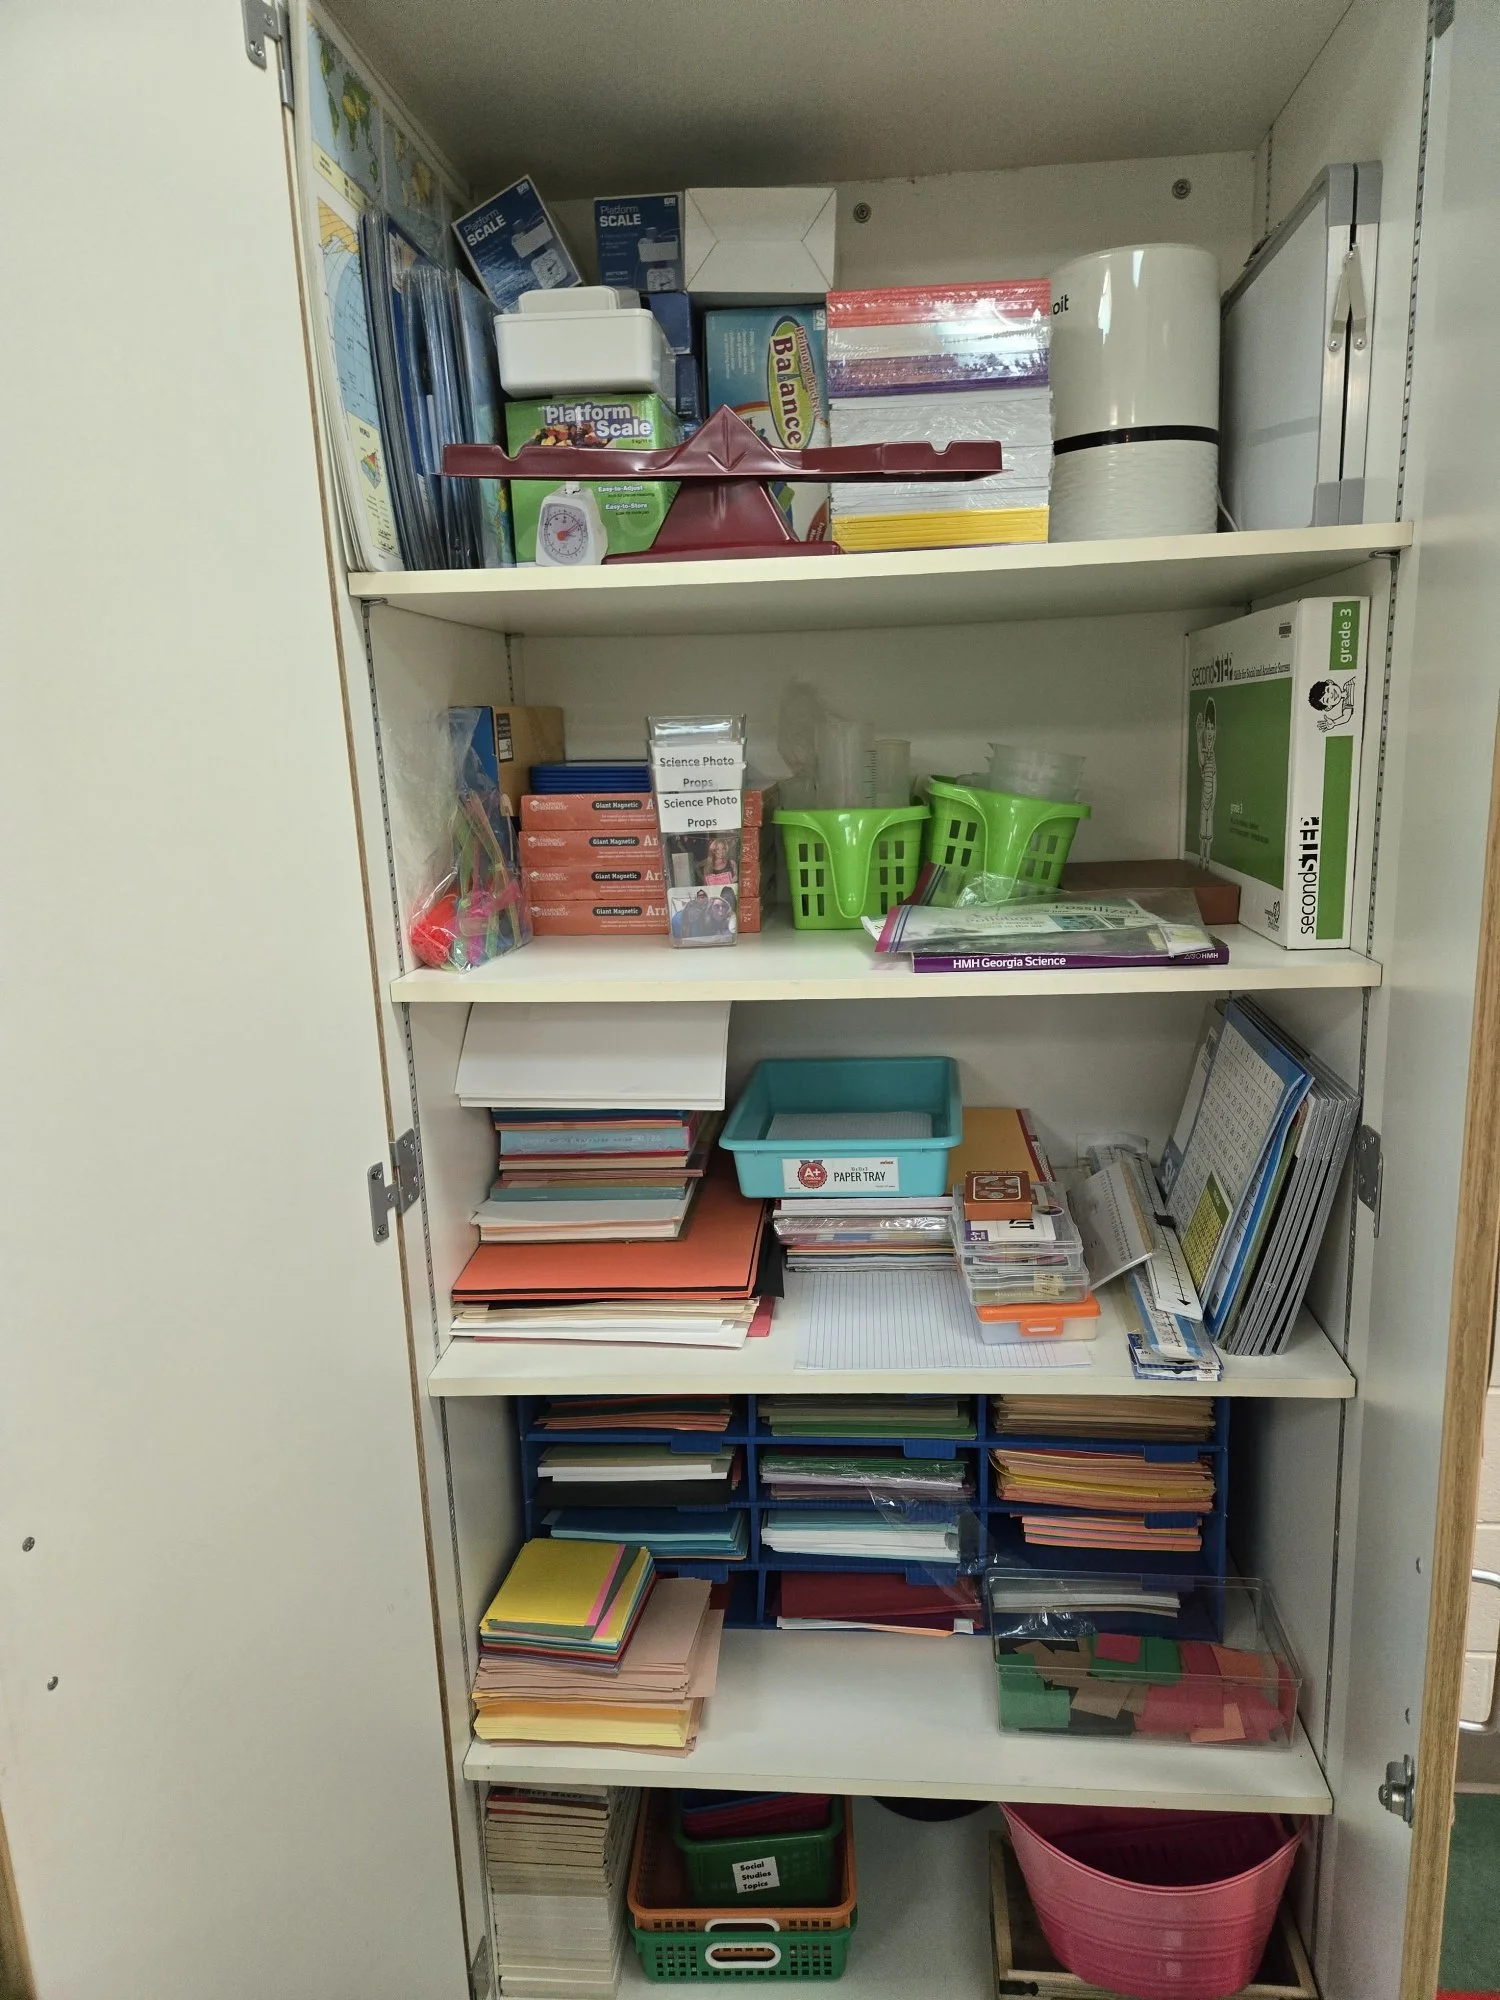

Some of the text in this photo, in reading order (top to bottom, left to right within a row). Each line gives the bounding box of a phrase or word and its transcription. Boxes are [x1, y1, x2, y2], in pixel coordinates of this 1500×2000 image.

[600, 204, 639, 215] Platform
[464, 209, 499, 234] Platform
[599, 213, 642, 227] SCALE
[466, 214, 507, 247] SCALE
[795, 327, 811, 374] Primary
[773, 336, 802, 445] Balance
[546, 405, 631, 424] Platform
[596, 419, 651, 437] Scale
[1338, 608, 1353, 664] grade 3
[660, 756, 735, 768] Science Photo
[683, 778, 713, 789] Props
[664, 795, 738, 809] Science Photo
[687, 818, 718, 829] Props
[613, 908, 639, 916] Magnetic
[953, 955, 1067, 969] HMH Georgia Science
[804, 1167, 821, 1177] A+
[833, 1171, 886, 1182] PAPER TRAY
[740, 1861, 765, 1871] Social
[742, 1871, 772, 1881] Studies
[743, 1881, 769, 1890] Topics
